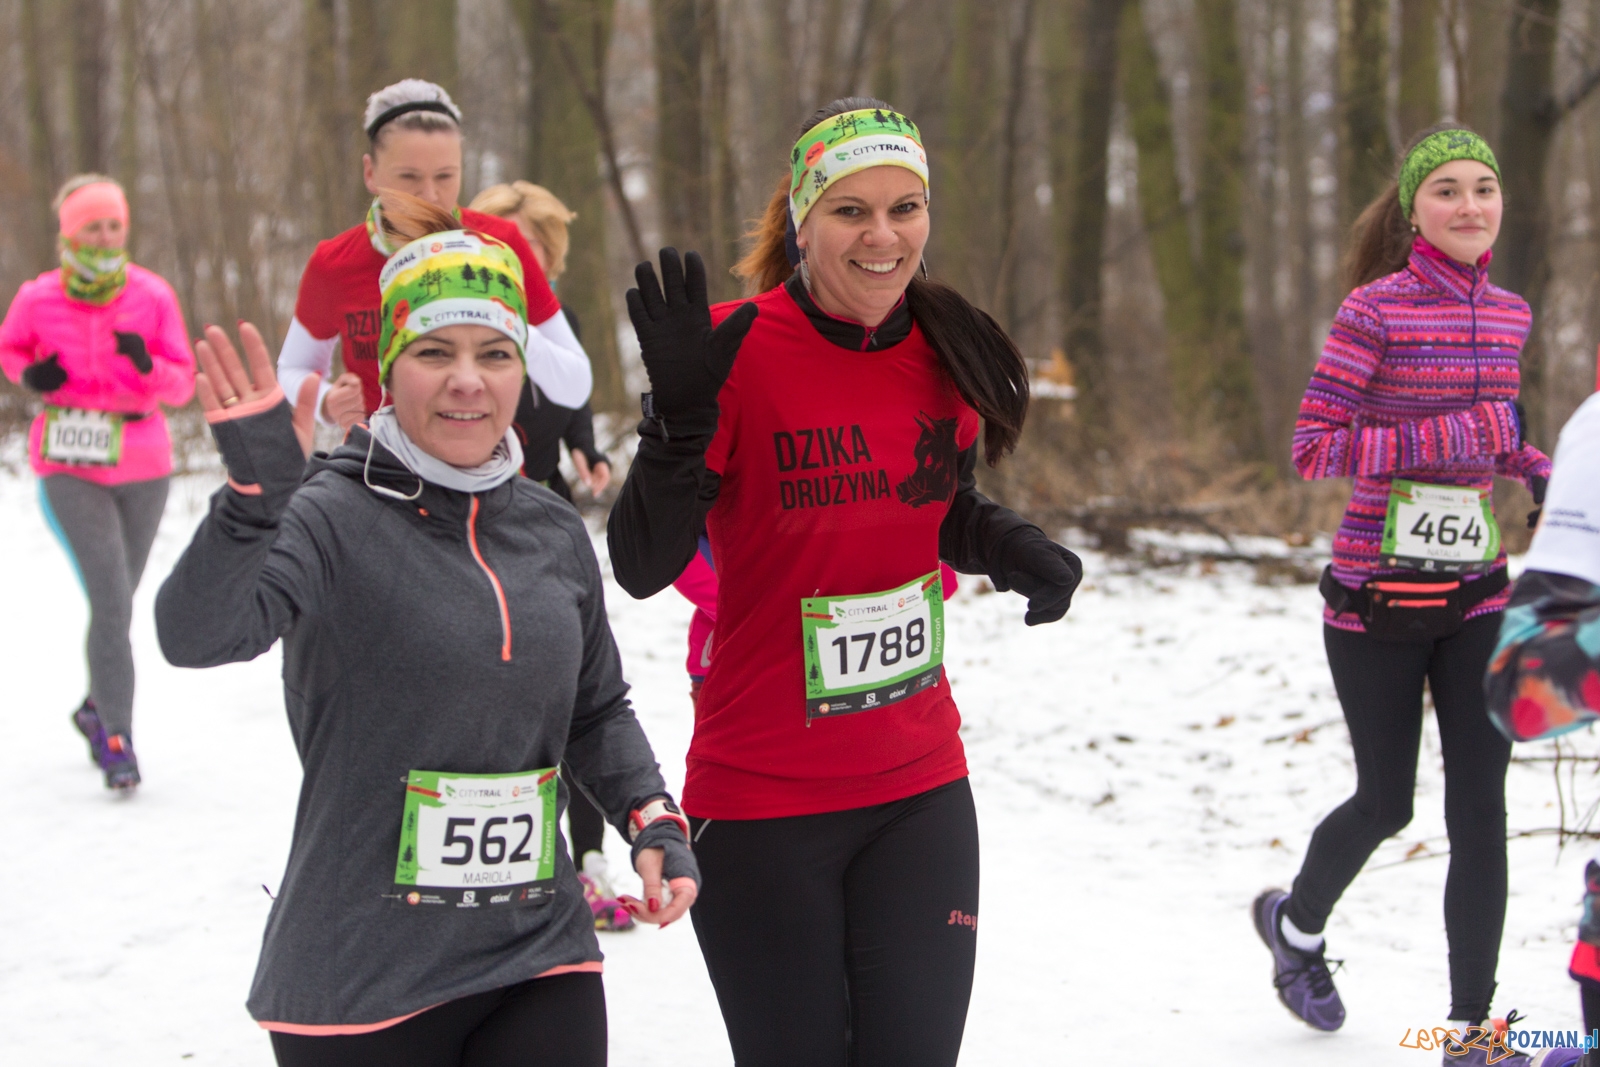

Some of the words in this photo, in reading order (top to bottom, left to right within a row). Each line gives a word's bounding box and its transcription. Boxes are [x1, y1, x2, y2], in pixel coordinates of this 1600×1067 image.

[345, 309, 381, 338] DZI
[55, 424, 109, 449] 1008
[773, 424, 872, 473] DZIKA
[779, 469, 891, 510] DRUŻYNA
[1410, 512, 1482, 547] 464
[1427, 548, 1461, 558] NATALIA
[831, 617, 925, 675] 1788
[441, 813, 533, 866] 562
[462, 871, 512, 884] MARIOLA
[947, 910, 977, 931] Stay
